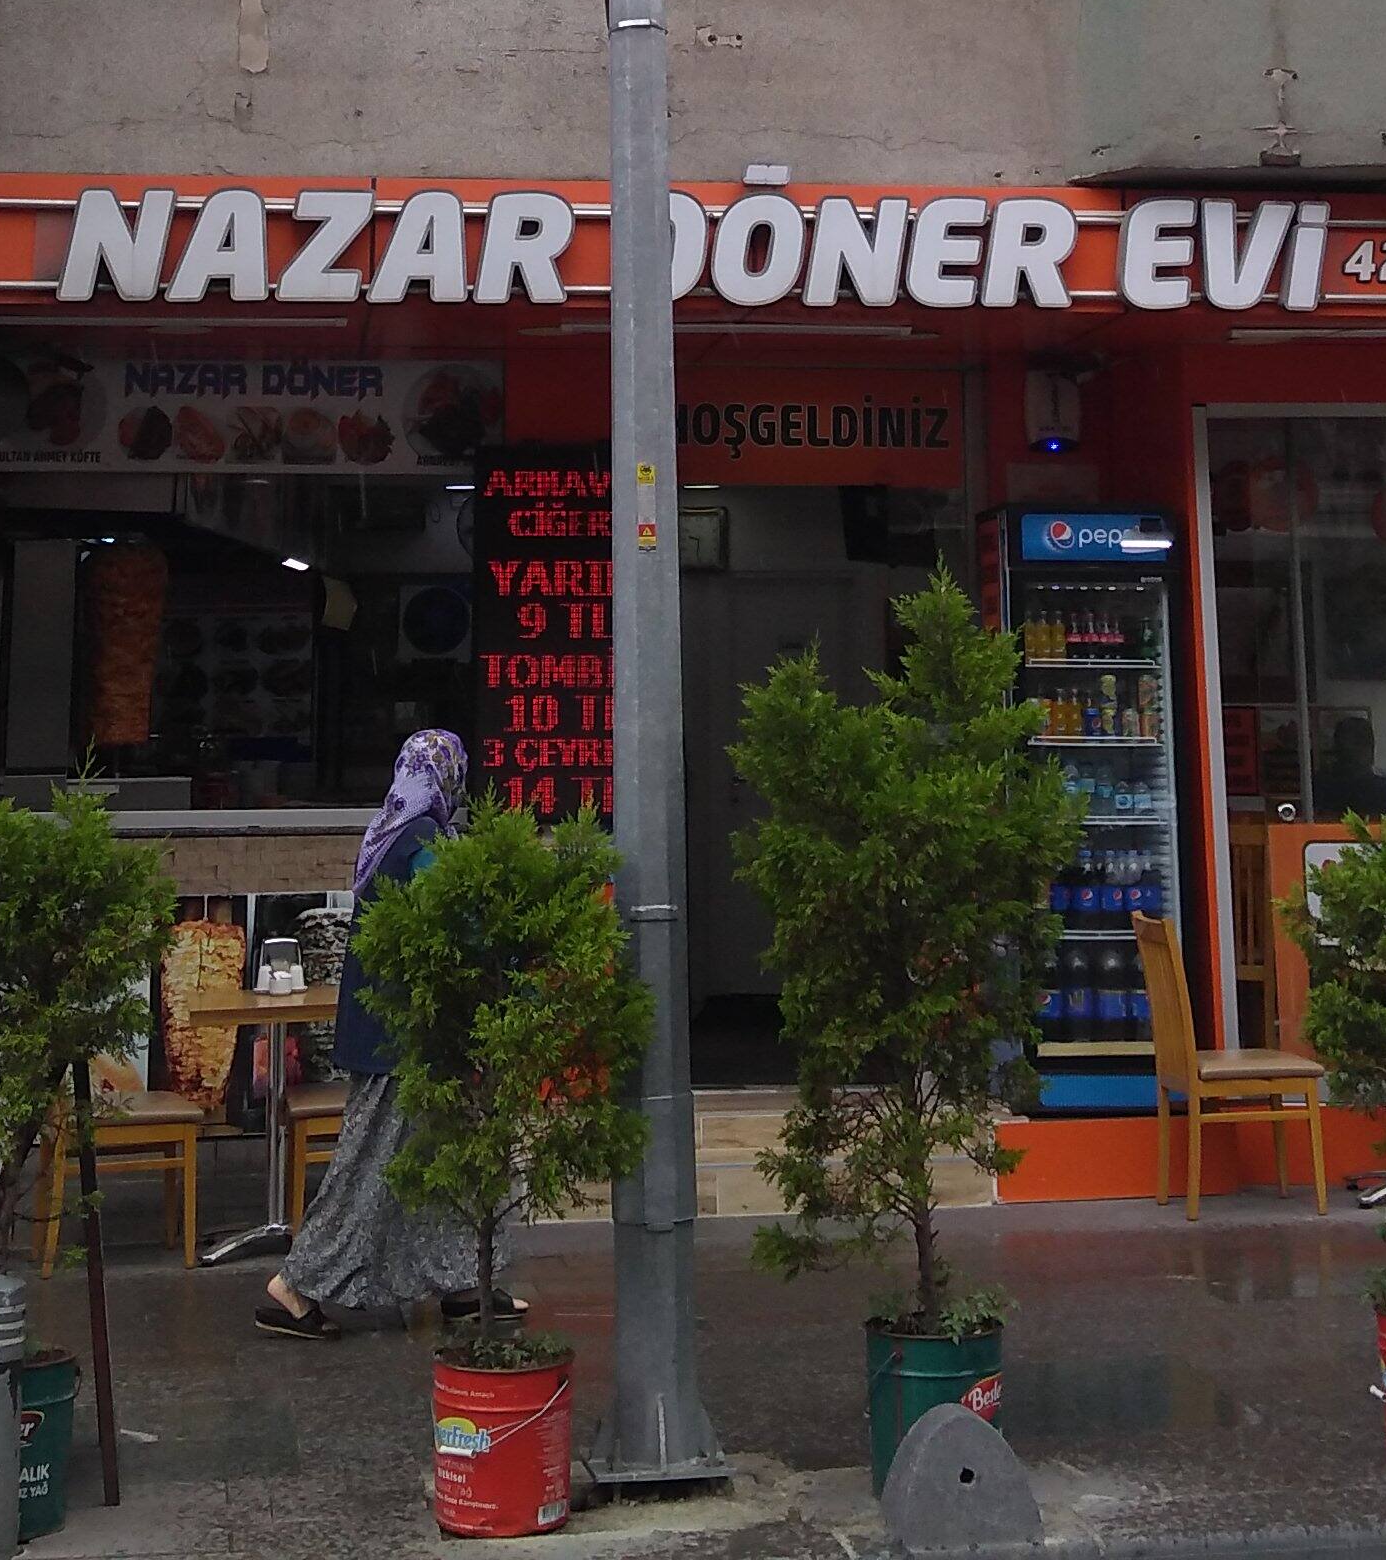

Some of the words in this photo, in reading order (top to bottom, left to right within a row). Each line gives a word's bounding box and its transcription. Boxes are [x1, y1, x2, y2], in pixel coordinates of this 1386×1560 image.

[55, 187, 575, 305] NAZAR
[1119, 196, 1331, 312] EVİ
[125, 362, 247, 399] NAZAR
[262, 358, 383, 401] DÖNER
[70, 448, 102, 463] KÖFTE
[484, 470, 611, 497] ARNAV
[1078, 528, 1130, 549] pep
[488, 561, 613, 597] YARI
[516, 603, 547, 639] 9
[559, 603, 612, 639] TL
[480, 653, 613, 689] TOMB
[504, 695, 560, 732] 10
[483, 739, 505, 767] 3
[514, 739, 613, 772] ÇEYR
[503, 776, 557, 814] 14
[29, 1482, 49, 1498] YAĞ
